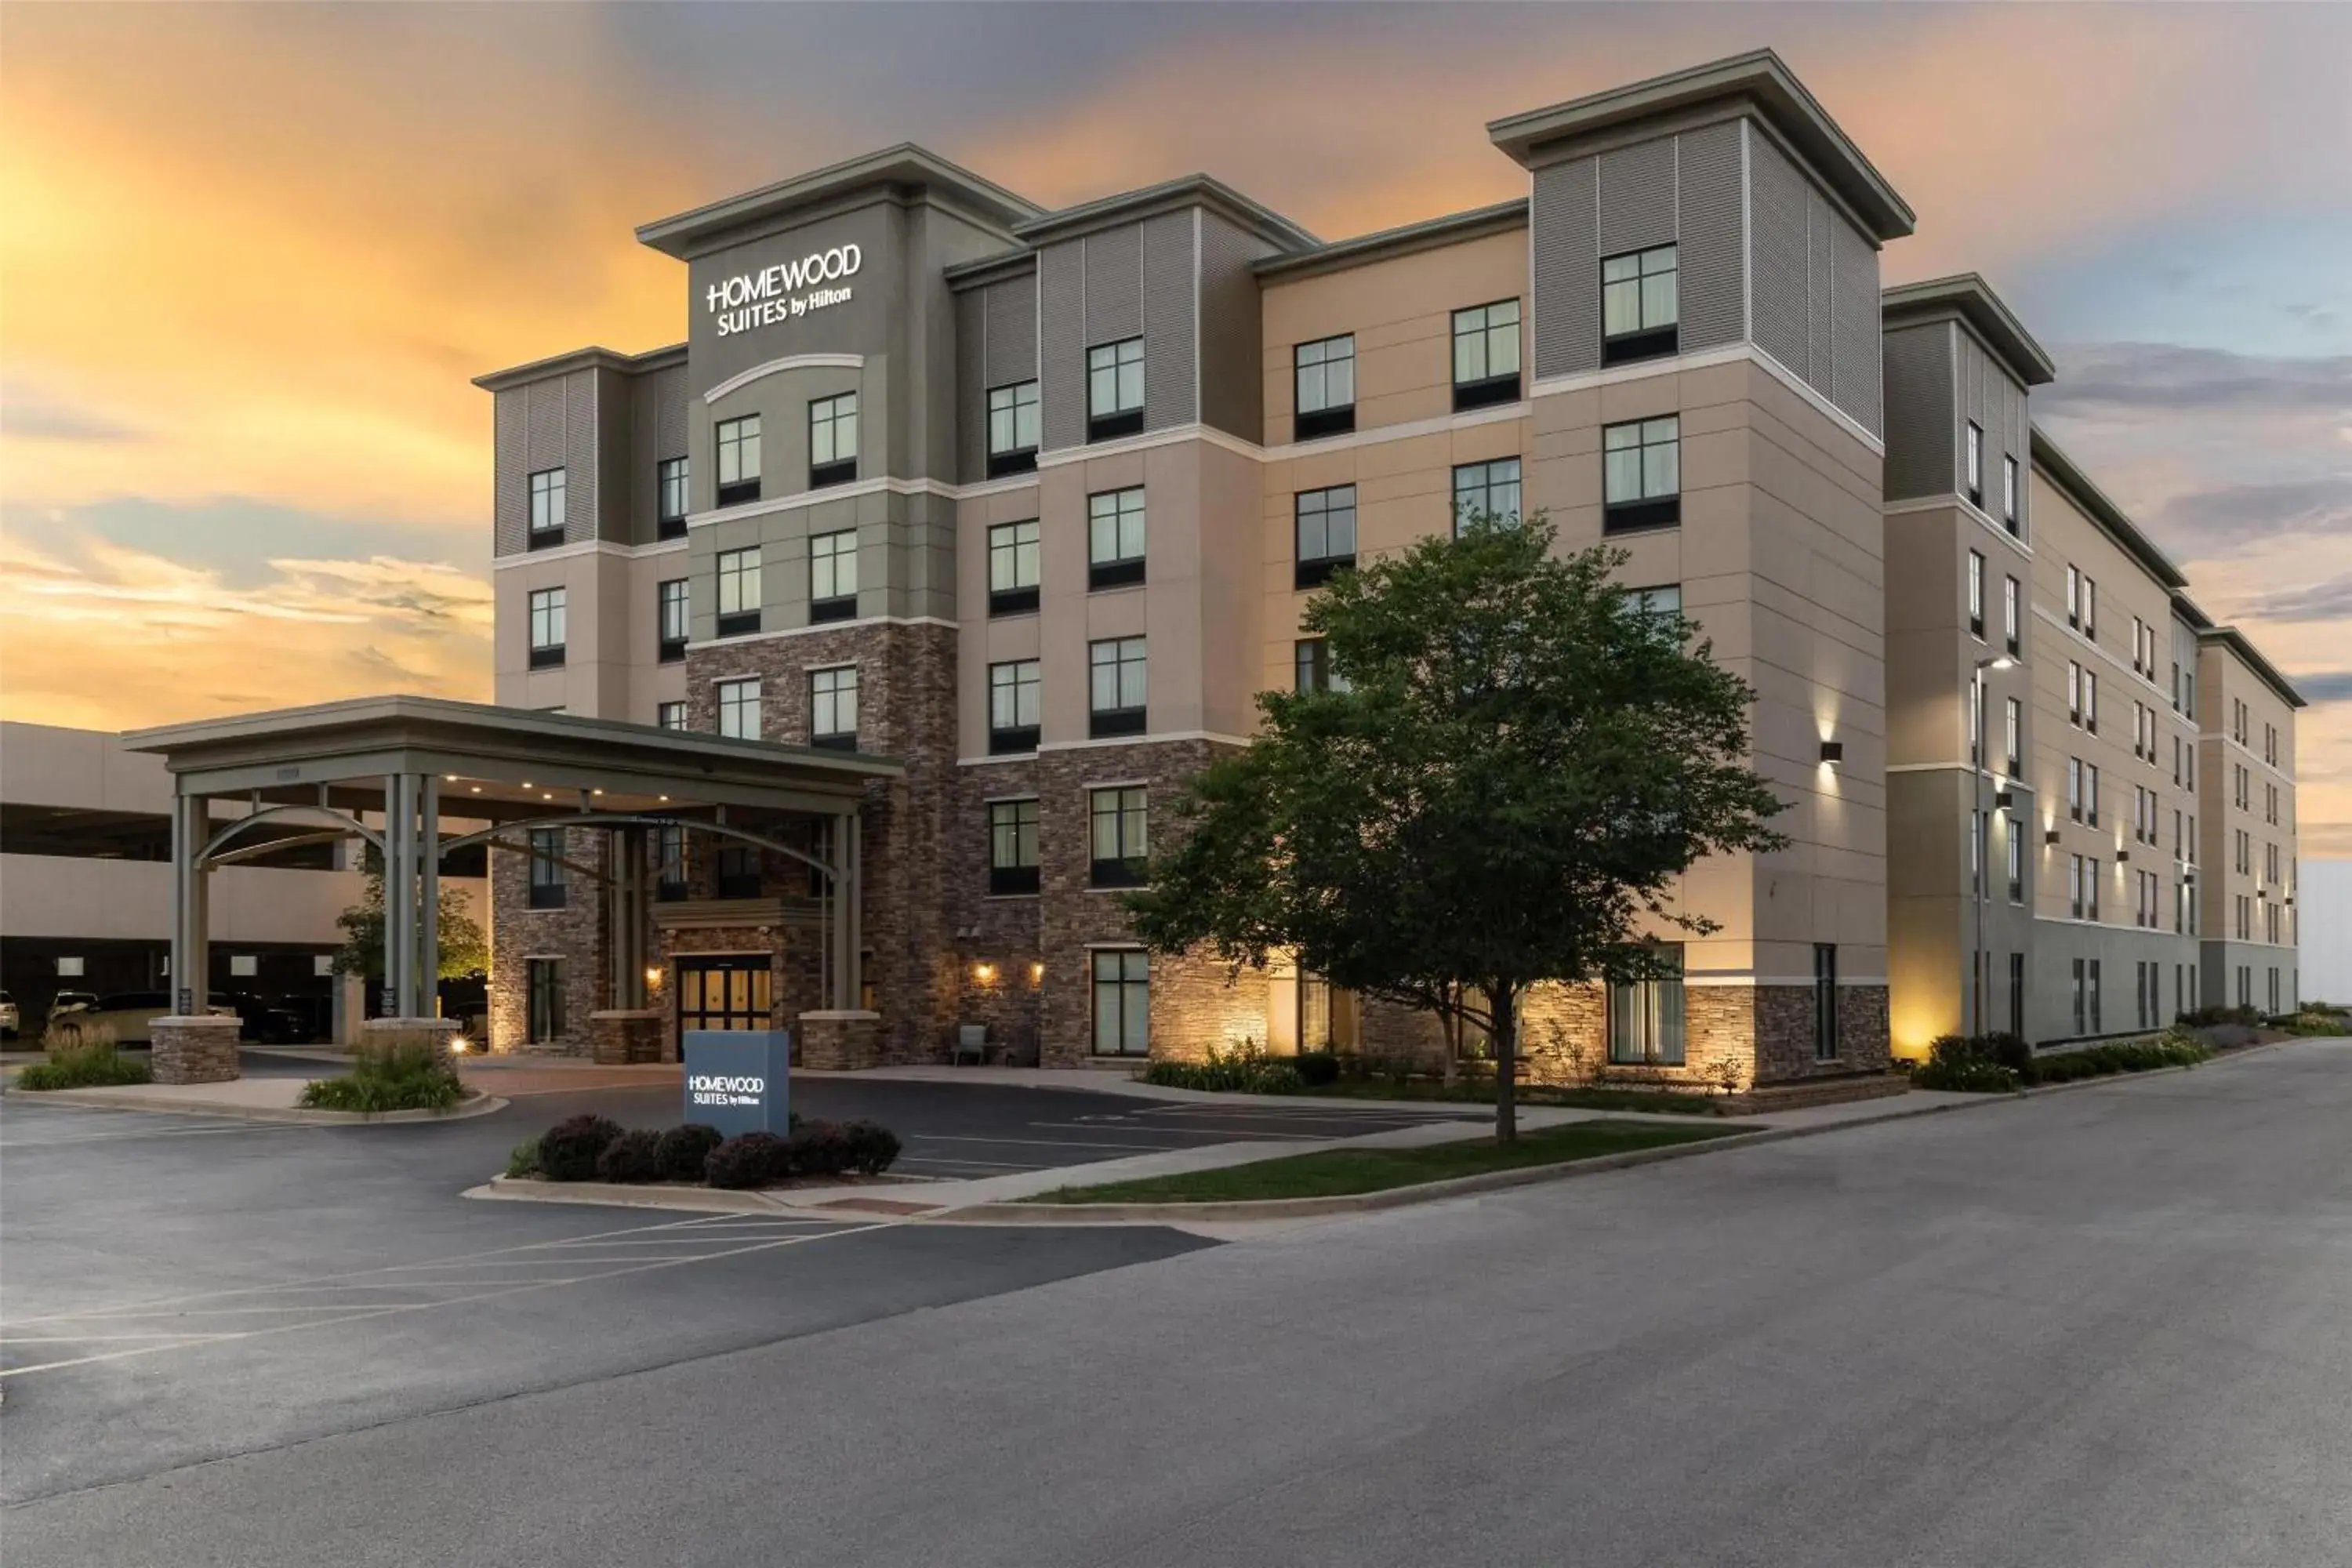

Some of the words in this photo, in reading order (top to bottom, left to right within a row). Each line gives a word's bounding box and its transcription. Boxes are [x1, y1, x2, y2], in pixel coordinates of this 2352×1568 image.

[706, 244, 861, 313] HOMEWOOD
[717, 299, 786, 336] SUITES
[791, 297, 808, 317] by
[808, 287, 851, 310] Hilton
[689, 1075, 764, 1092] HOMEWOOD
[693, 1093, 728, 1105] SUITES
